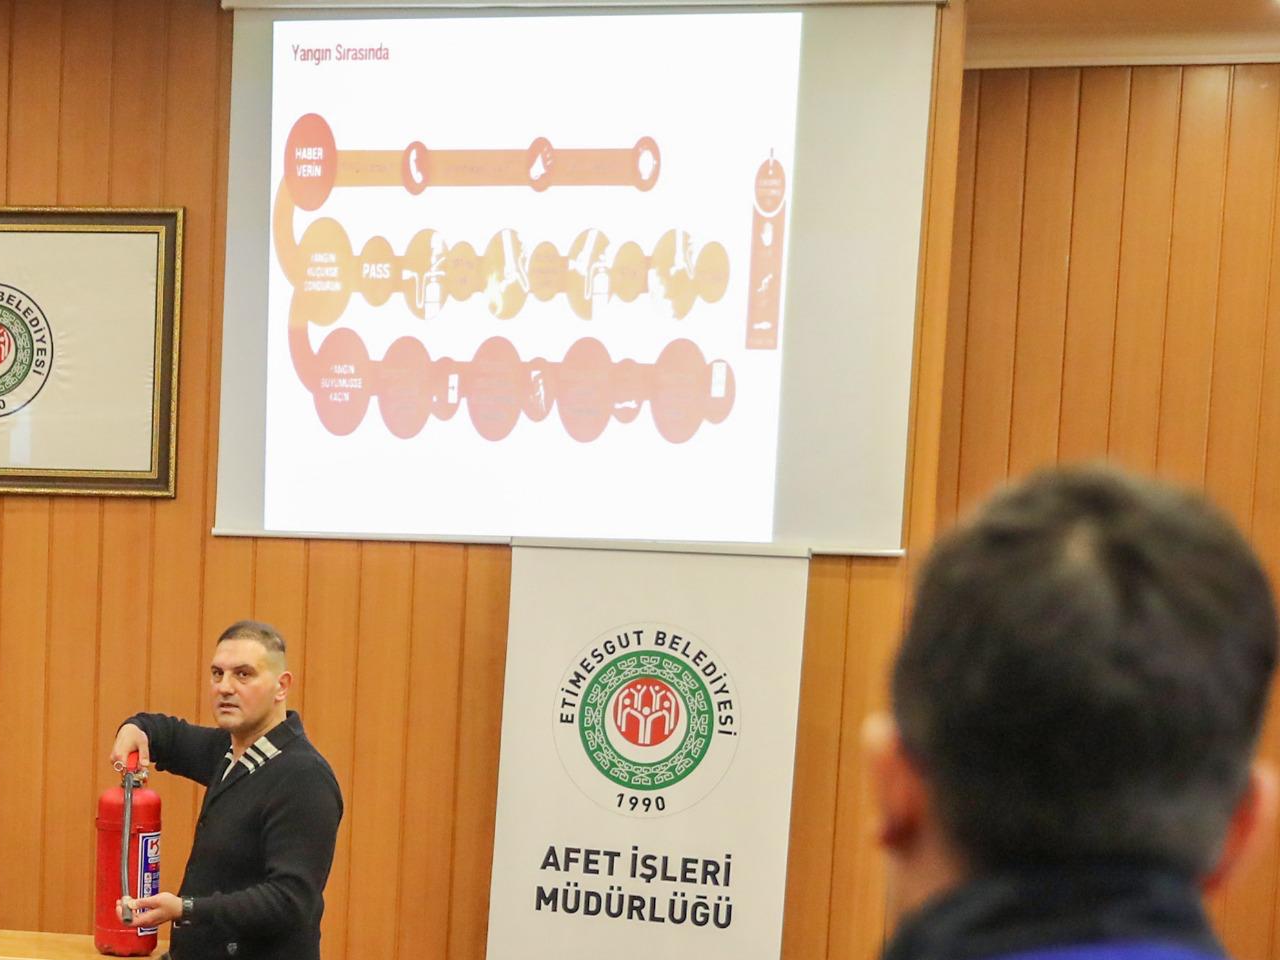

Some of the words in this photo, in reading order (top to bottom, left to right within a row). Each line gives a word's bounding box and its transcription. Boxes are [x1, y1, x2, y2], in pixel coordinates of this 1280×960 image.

[291, 44, 331, 66] Yangın
[335, 42, 389, 61] Sırasında
[295, 147, 323, 160] HABER
[362, 263, 391, 279] PASS
[559, 630, 644, 724] ETİMESGUT
[654, 630, 737, 736] BELEDİYESİ
[616, 793, 665, 812] 1990
[540, 845, 620, 876] AFET
[629, 846, 732, 887] İŞLERİ
[534, 881, 733, 929] MÜDÜRLÜĞÜ
